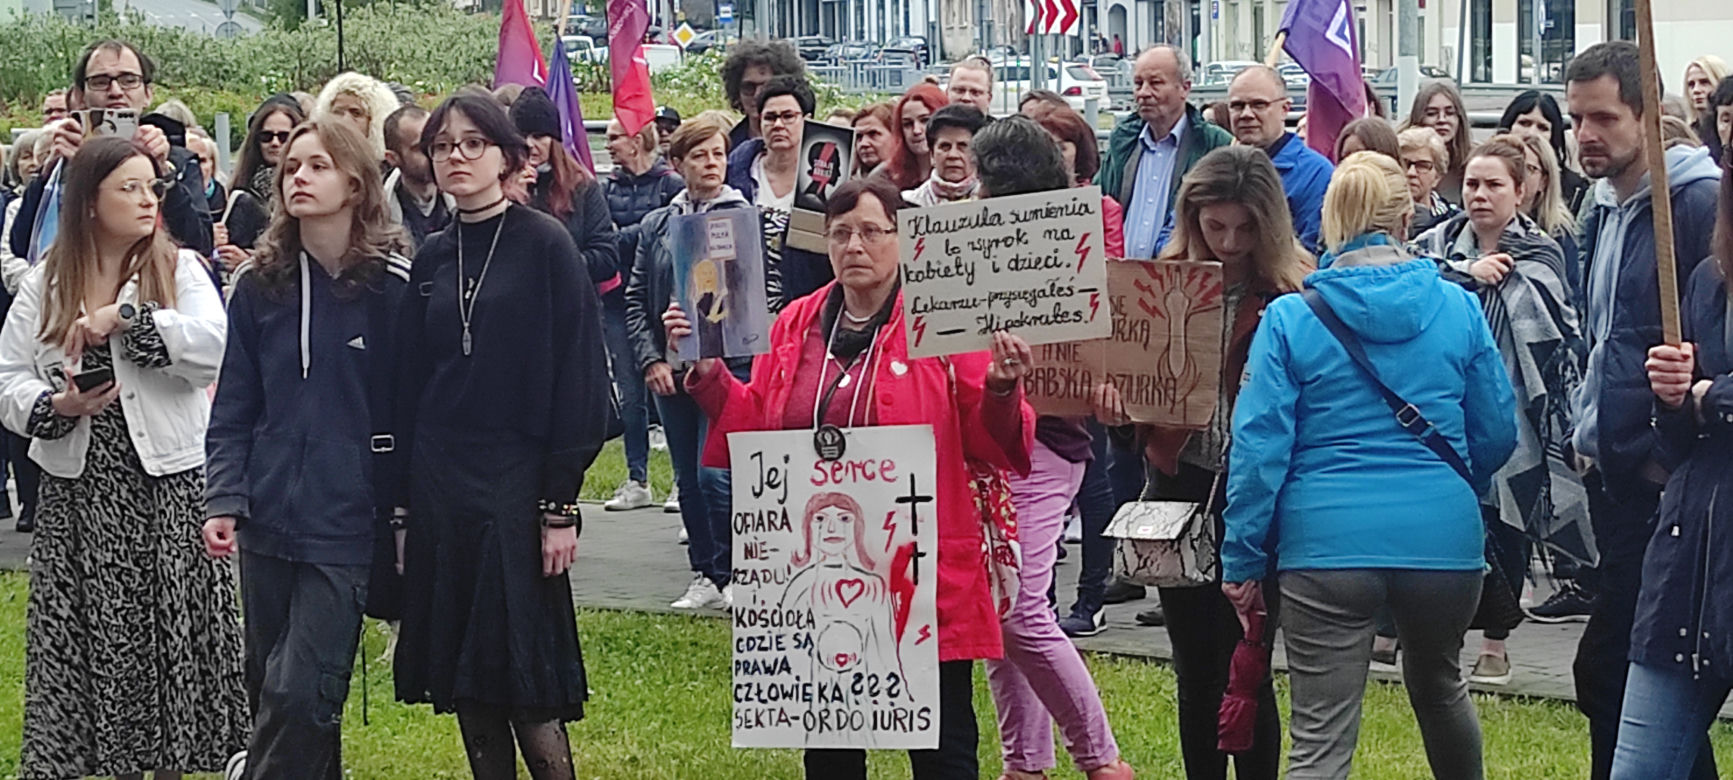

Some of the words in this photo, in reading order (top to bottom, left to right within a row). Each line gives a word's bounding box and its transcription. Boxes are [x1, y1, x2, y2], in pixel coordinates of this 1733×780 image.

[908, 206, 1004, 239] Klauzula
[1009, 197, 1095, 227] sumienia
[967, 228, 1028, 259] wyrok
[1043, 228, 1075, 241] na
[903, 256, 975, 286] kobiety
[992, 255, 1001, 273] i
[1008, 248, 1071, 271] dzieci.
[1056, 343, 1081, 363] NIE
[750, 451, 789, 504] Jej
[810, 459, 898, 486] serce
[734, 506, 792, 535] OFIARA
[735, 600, 816, 630] KOŚCIOŁA
[793, 632, 815, 657] SĄ
[735, 655, 792, 676] PRAWA
[872, 707, 931, 733] IURIS
